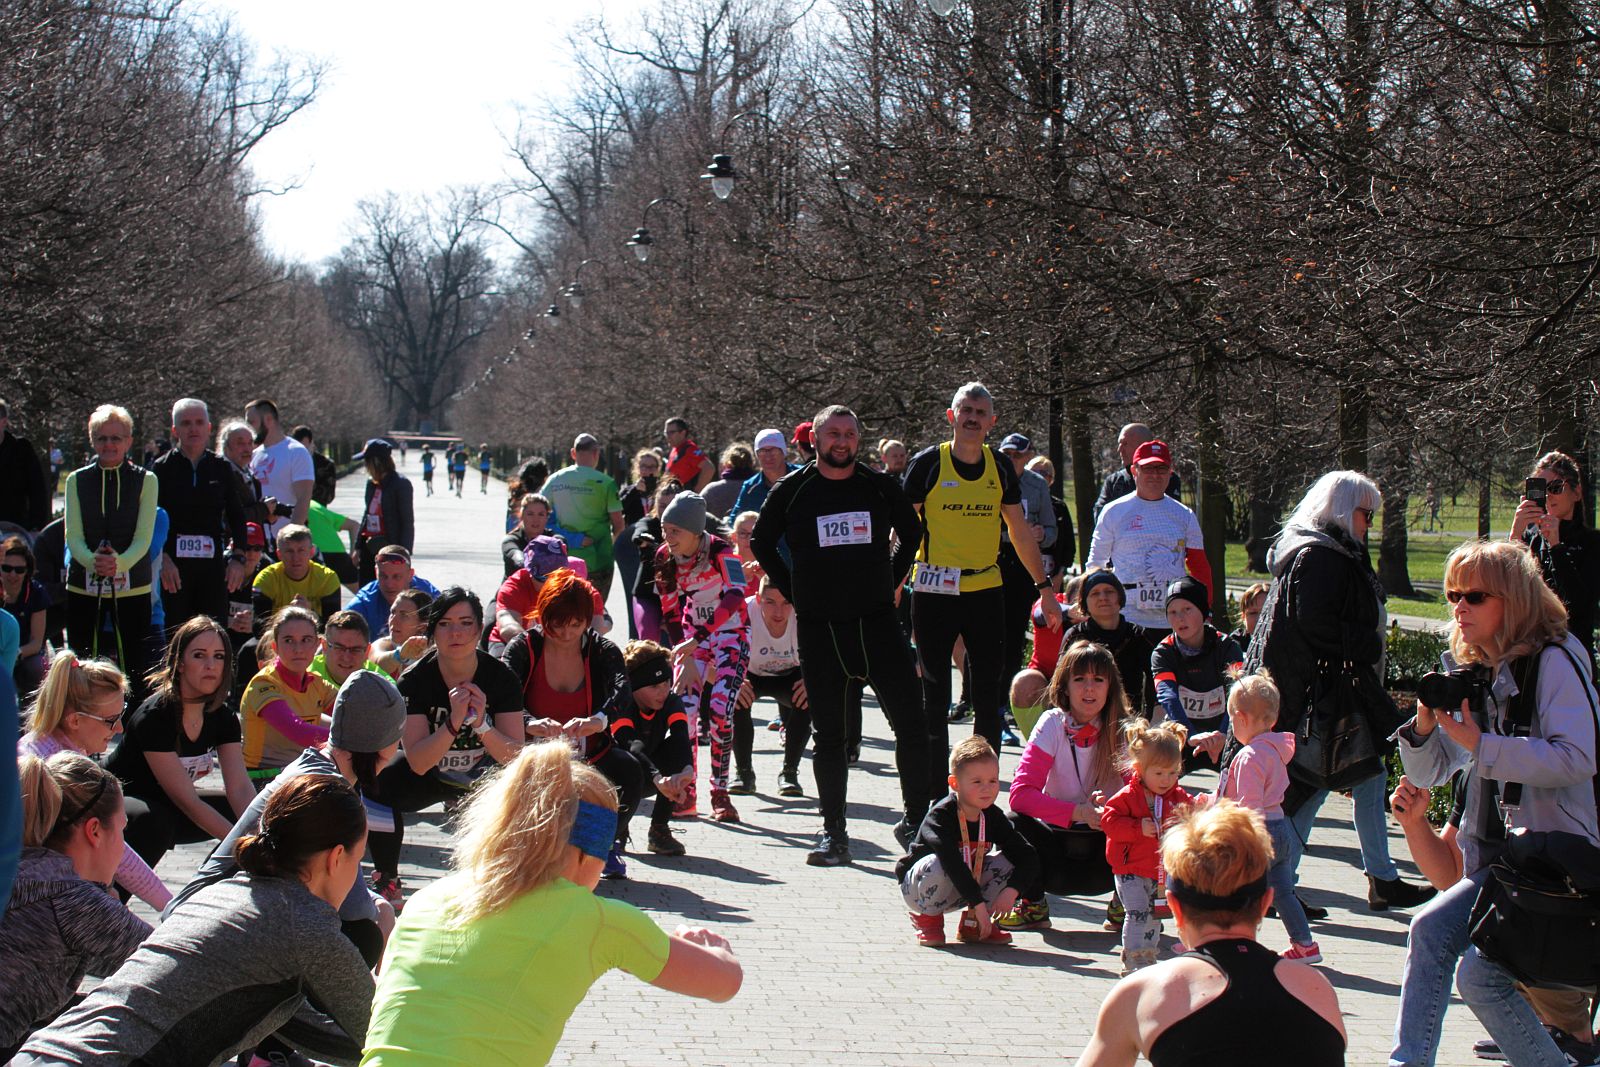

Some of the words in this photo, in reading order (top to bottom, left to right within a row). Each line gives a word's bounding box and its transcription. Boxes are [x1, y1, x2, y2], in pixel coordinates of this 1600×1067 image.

[823, 521, 849, 538] 126
[180, 540, 201, 551] 093
[920, 571, 940, 586] 071
[1140, 589, 1162, 602] 042
[1183, 697, 1204, 712] 127
[439, 755, 470, 767] 063
